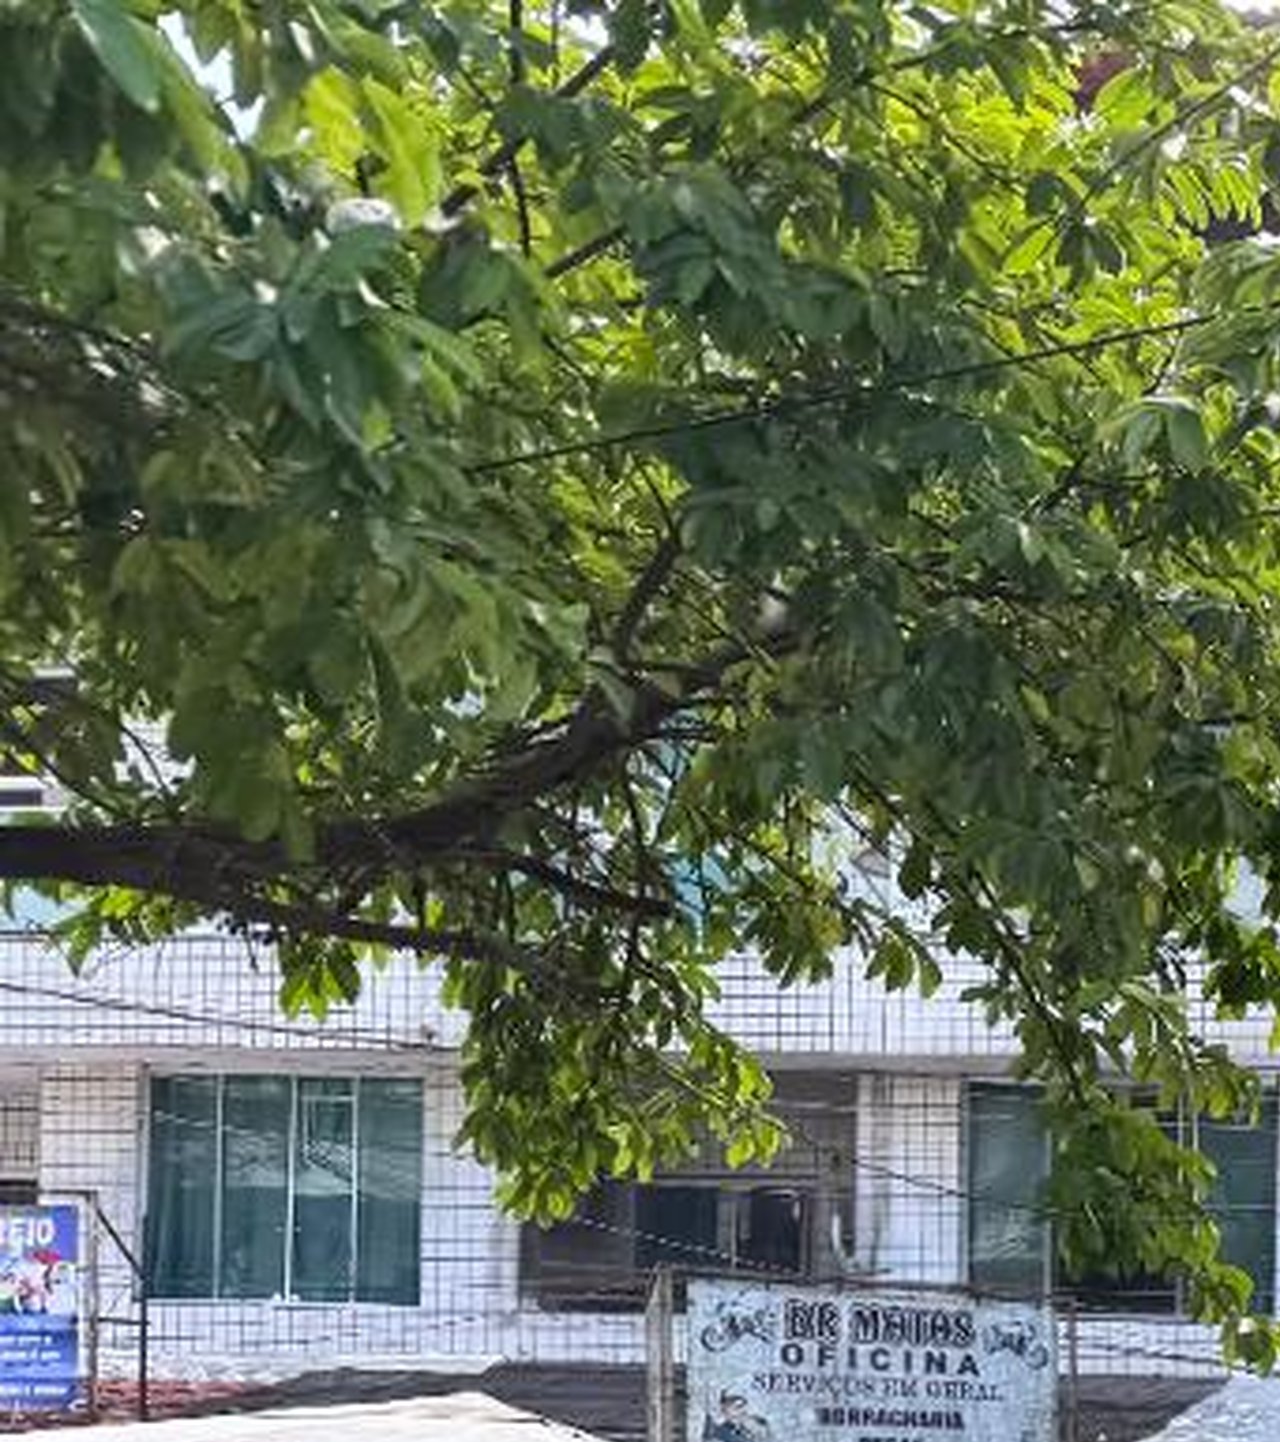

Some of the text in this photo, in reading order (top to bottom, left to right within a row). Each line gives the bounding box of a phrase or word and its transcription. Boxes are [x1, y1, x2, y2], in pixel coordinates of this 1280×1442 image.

[780, 1342, 981, 1377] OFICINA
[880, 1376, 918, 1399] EM
[924, 1379, 1004, 1402] GERAL
